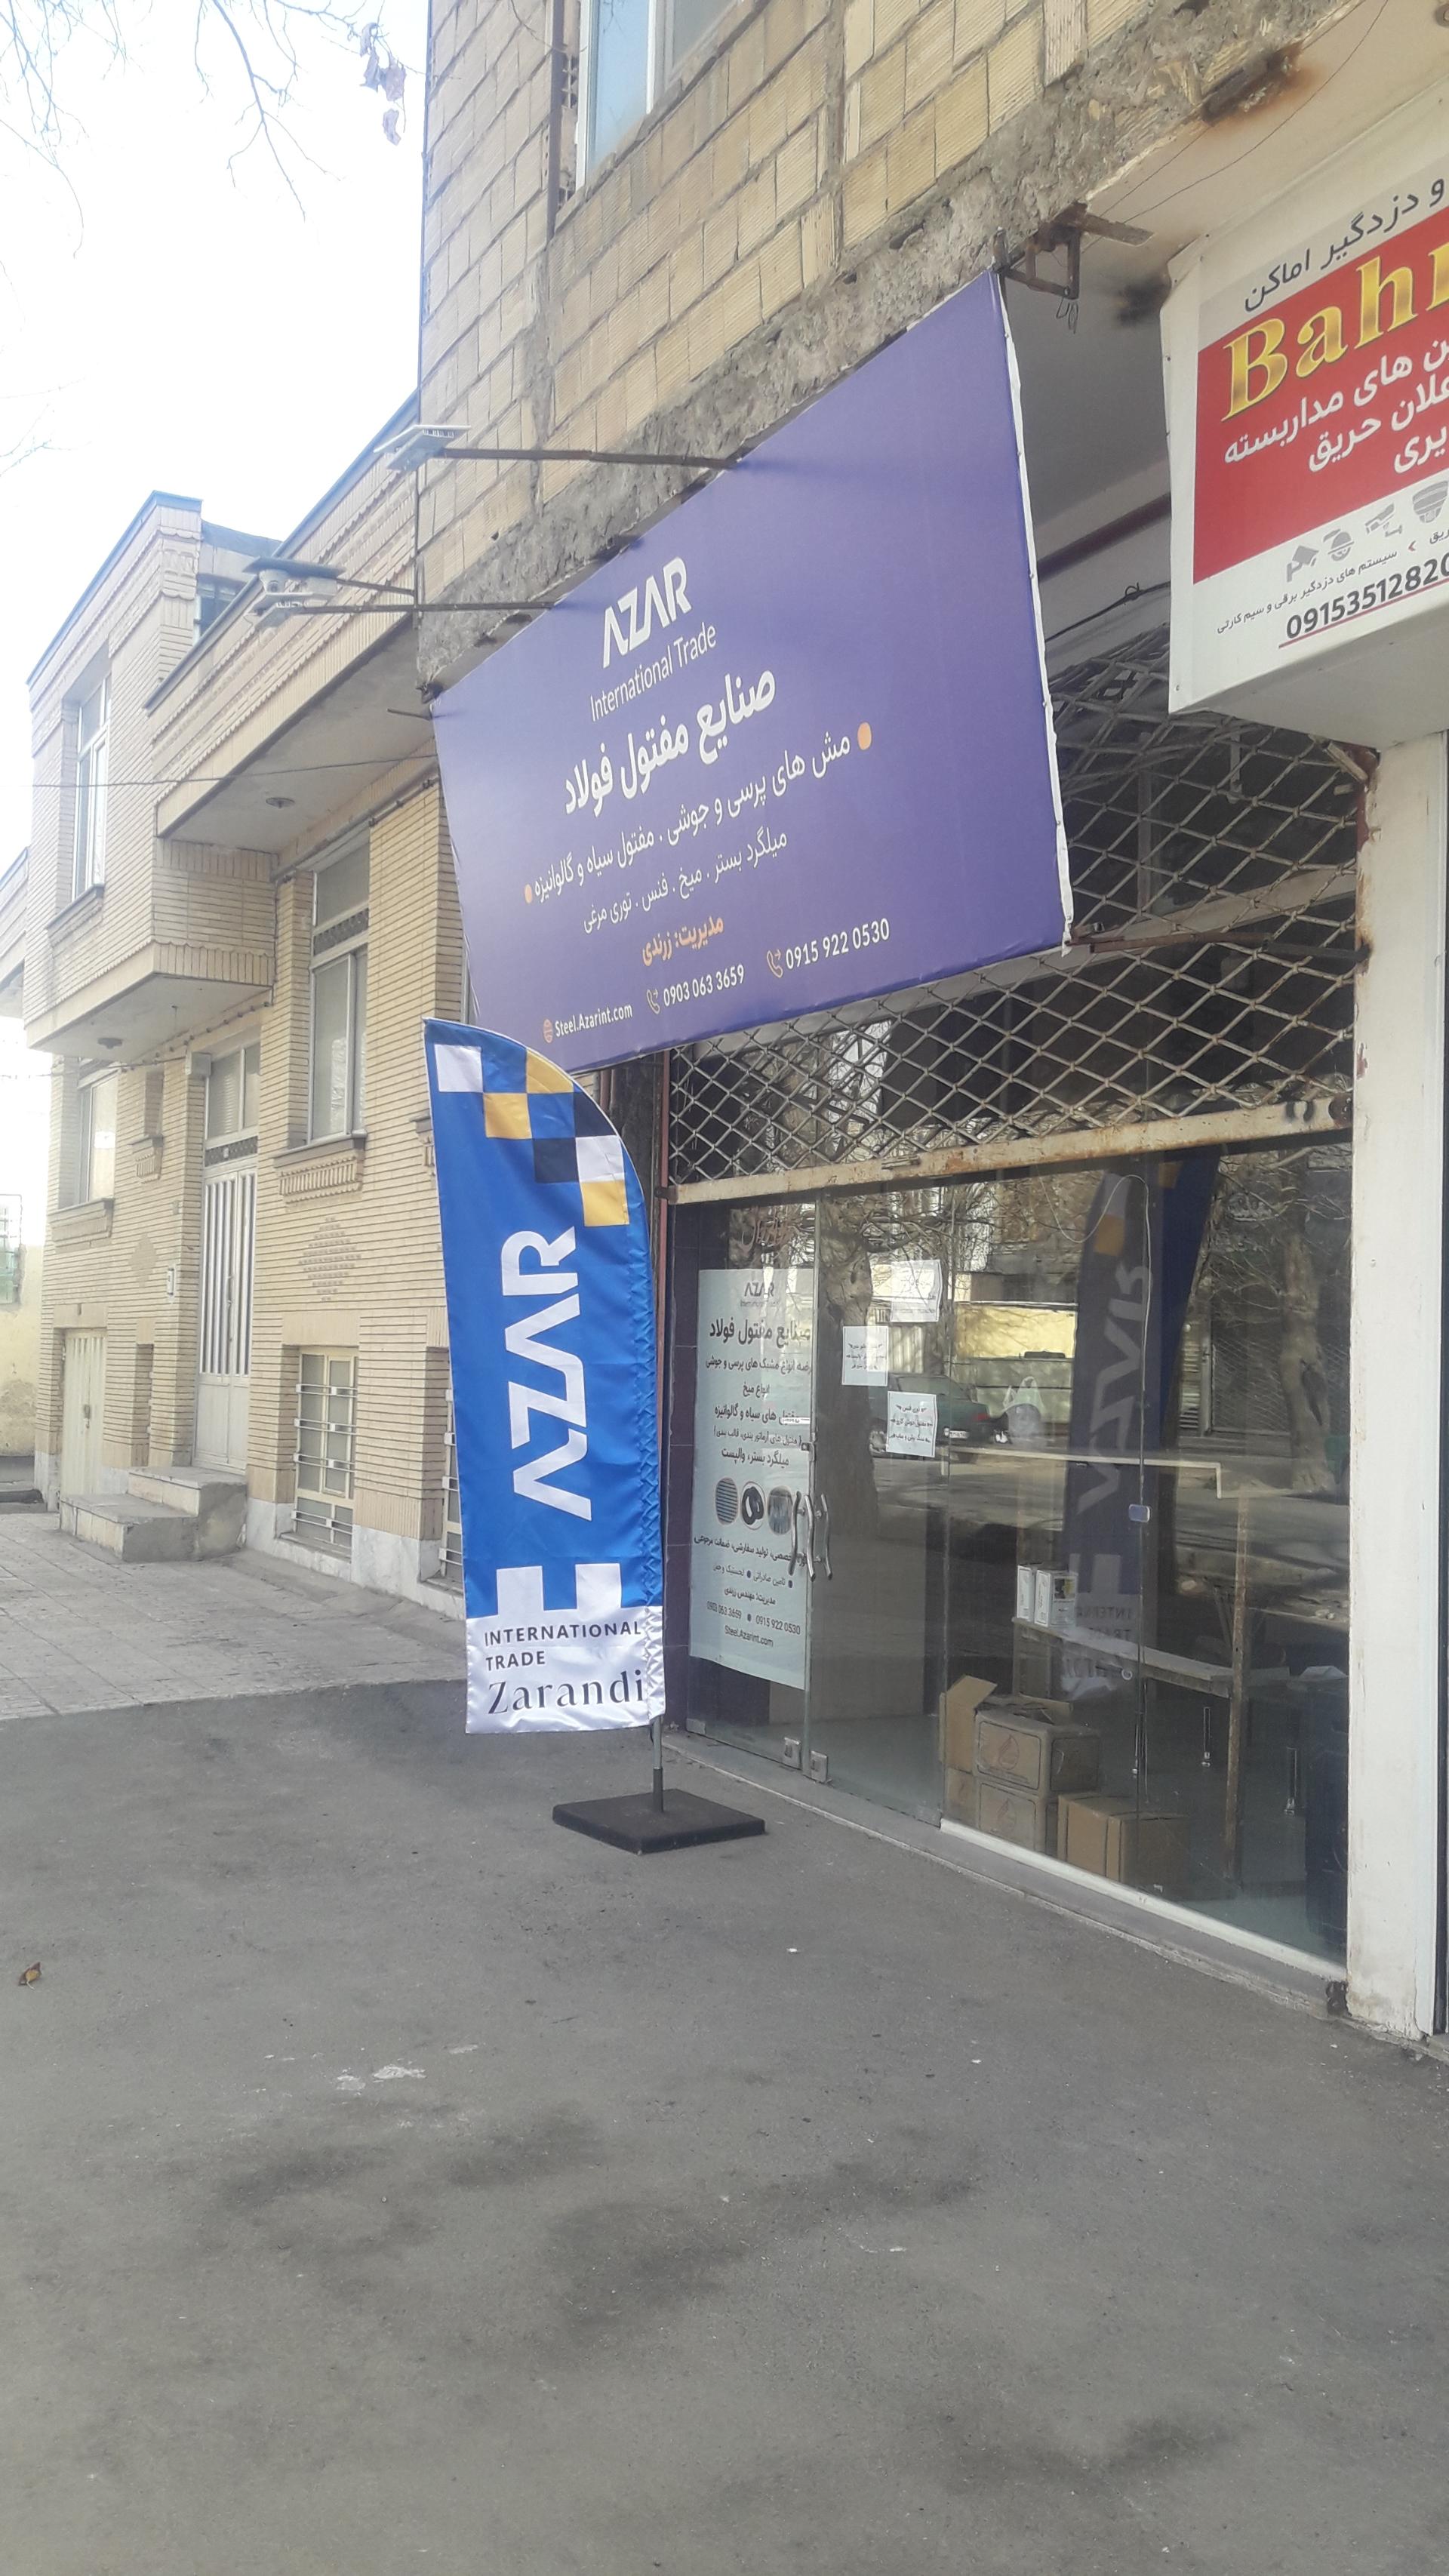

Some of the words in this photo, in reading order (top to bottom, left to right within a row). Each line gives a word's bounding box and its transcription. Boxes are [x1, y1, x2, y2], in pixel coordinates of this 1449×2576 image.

[1429, 178, 1444, 208] و
[1320, 193, 1420, 270] دزدگیر
[1245, 248, 1310, 312] اماکن
[1353, 355, 1413, 407] های
[1224, 391, 1344, 463] مداربسته
[1309, 417, 1382, 472] حریق
[1336, 567, 1355, 584] های
[1358, 551, 1398, 576] سیستم
[1275, 592, 1298, 611] برقی
[1300, 576, 1334, 599] دزدگیر
[603, 556, 692, 669] AZAR
[1217, 613, 1242, 634] کارتی
[1243, 607, 1265, 623] سیم
[1266, 603, 1272, 614] و
[590, 645, 673, 722] International
[674, 621, 717, 668] Trade
[697, 670, 776, 765] صنایع
[620, 714, 688, 799] مفتول
[812, 731, 851, 778] مش
[565, 742, 614, 817] فولاد
[772, 750, 805, 796] های
[715, 798, 723, 825] و
[728, 776, 767, 817] پرسی
[667, 804, 709, 845] جوشی
[587, 845, 613, 877] سیاه
[617, 826, 654, 868] مفتول
[746, 826, 787, 868] میلگرد
[535, 851, 574, 903] گالوانیزه
[577, 863, 584, 886] و
[679, 867, 702, 899] میخ
[715, 851, 742, 883] بستر
[610, 892, 632, 924] توری
[641, 872, 668, 912] فنس
[583, 904, 607, 934] مرغی
[642, 929, 673, 967] زرندی
[786, 940, 819, 969] 0915
[823, 931, 849, 958] 922
[852, 918, 890, 949] 0530
[663, 982, 690, 1007] 0903
[692, 974, 713, 998] 063
[716, 964, 744, 991] 3659
[555, 1004, 633, 1038] Steel.Azarint.com
[709, 1316, 735, 1343] فولاد
[738, 1319, 773, 1345] مفتول
[501, 1226, 592, 1522] AZAR
[796, 1362, 811, 1374] رضه
[714, 1403, 739, 1419] گالوانیزه
[745, 1407, 761, 1422] سیاه
[761, 1408, 777, 1423] های
[767, 1451, 789, 1469] میلگرد
[484, 1620, 641, 1647] INTERNATIONAL
[755, 1614, 771, 1627] 0915
[771, 1618, 783, 1630] 922
[783, 1622, 801, 1636] 0530
[485, 1651, 546, 1671] TRADE
[488, 1669, 643, 1715] Zarandi
